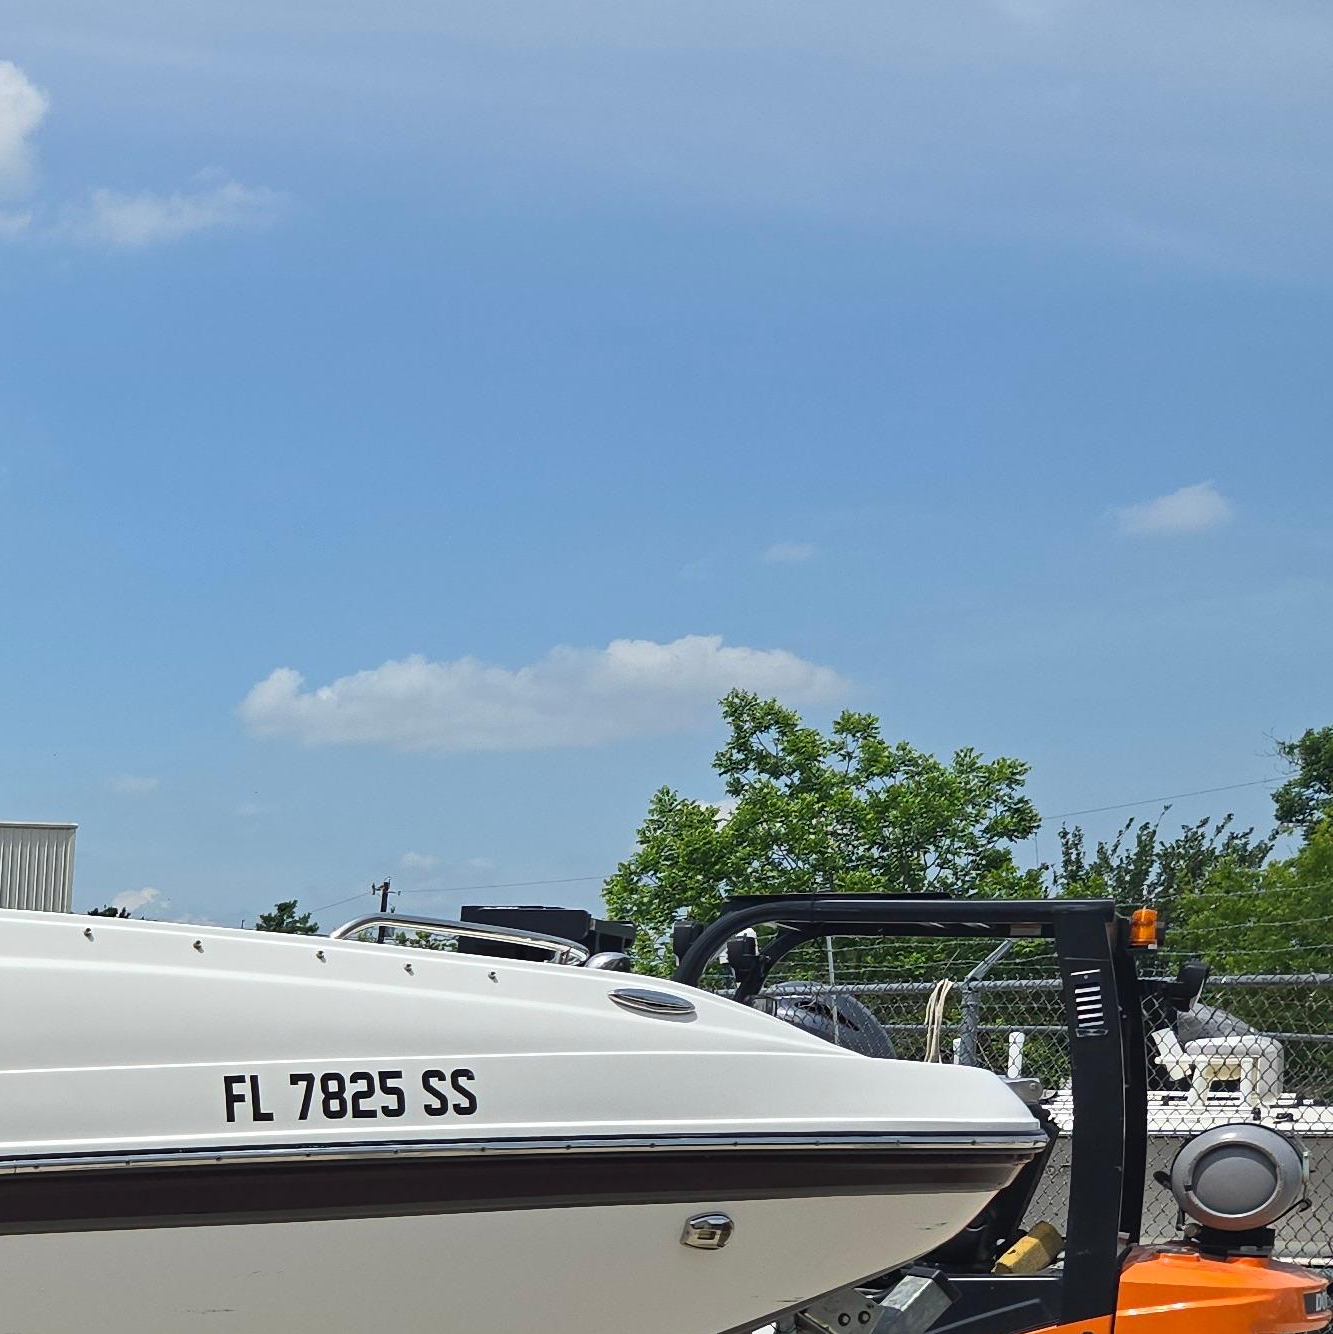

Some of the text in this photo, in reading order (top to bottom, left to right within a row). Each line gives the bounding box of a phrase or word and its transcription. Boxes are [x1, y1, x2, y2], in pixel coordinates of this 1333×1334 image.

[224, 1068, 478, 1122] FL 7825 SS
